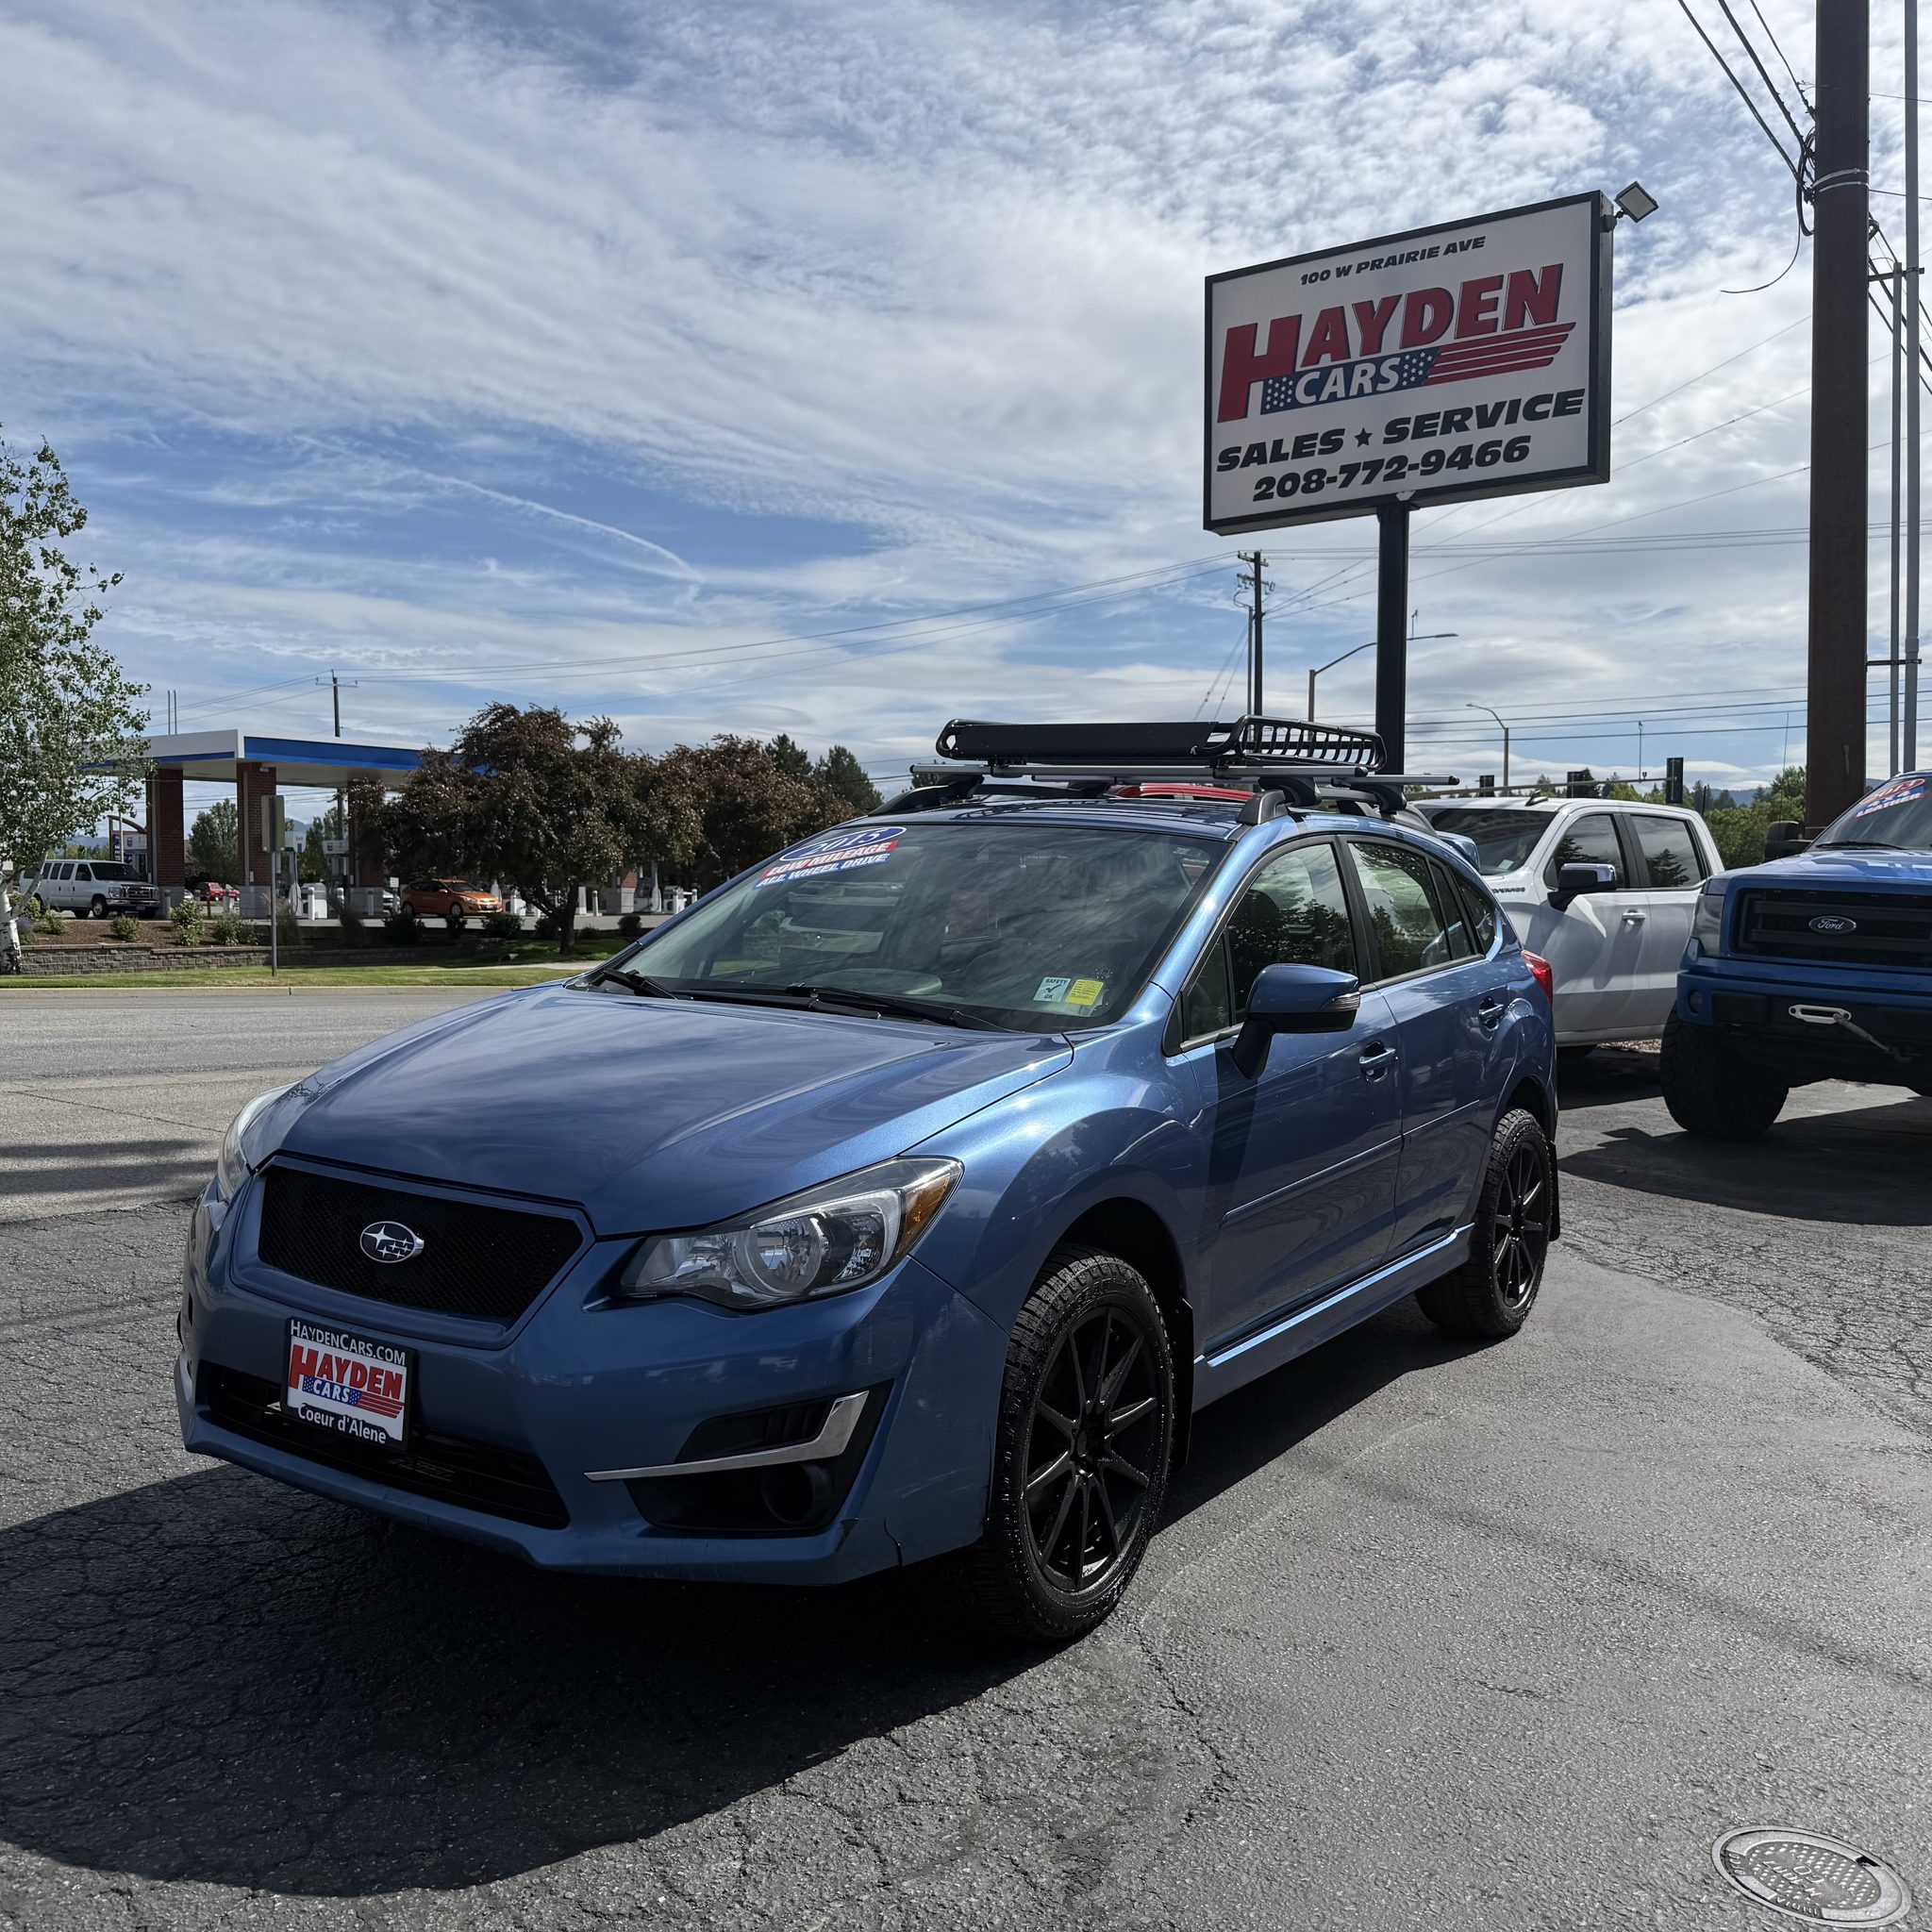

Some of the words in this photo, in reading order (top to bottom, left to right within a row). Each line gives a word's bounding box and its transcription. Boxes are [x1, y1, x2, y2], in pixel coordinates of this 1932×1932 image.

[1301, 271, 1331, 285] 100
[1336, 264, 1353, 278] W
[1356, 246, 1441, 275] PRAIRIE
[1443, 236, 1486, 255] AVE
[1217, 263, 1564, 424] HAYDEN
[1293, 357, 1401, 406] CARS
[1217, 427, 1346, 472] SALES
[1382, 389, 1586, 445] SERVICE
[1253, 435, 1532, 502] 208-772-9466
[757, 874, 787, 888] ALL
[788, 862, 839, 879] WHEEL
[841, 853, 891, 869] DRIVE
[766, 858, 808, 876] LOW
[808, 841, 891, 867] MILEAGE
[1817, 918, 1845, 930] Ford
[289, 1344, 403, 1401] HAYDEN
[312, 1378, 352, 1403] CARS
[297, 1404, 335, 1428] Coeur
[337, 1416, 387, 1444] d'Alene
